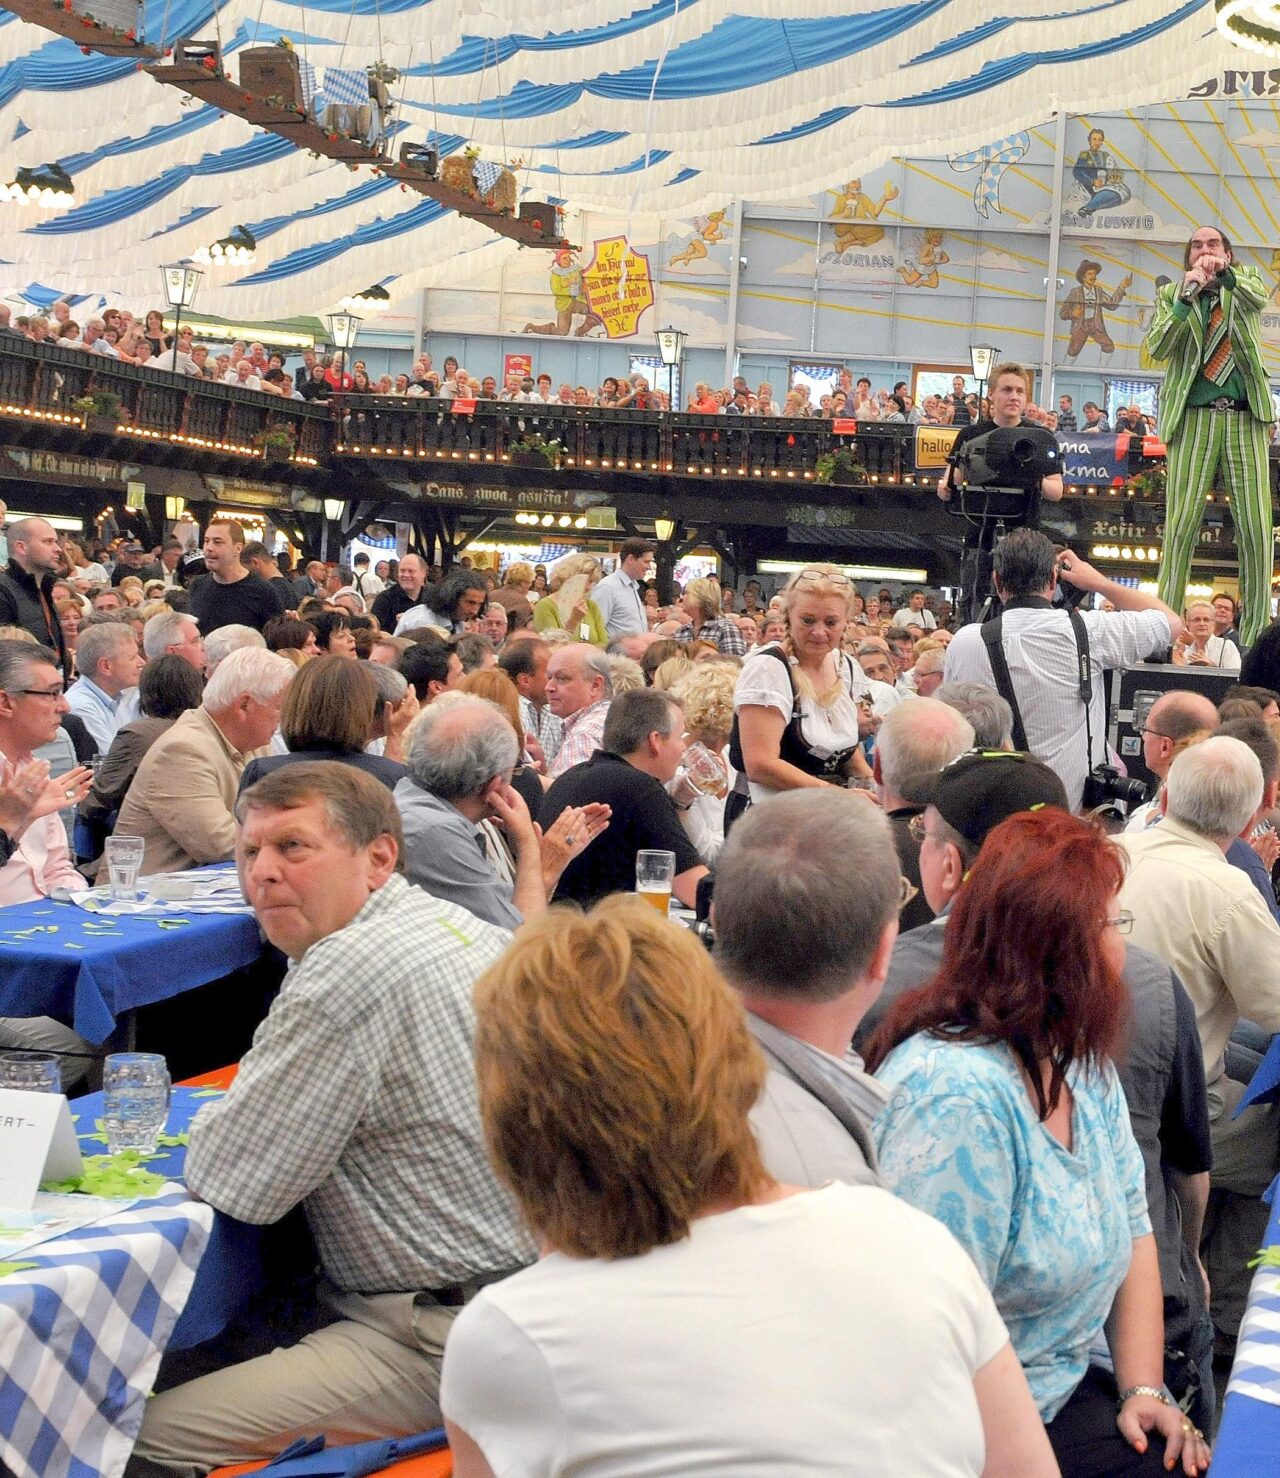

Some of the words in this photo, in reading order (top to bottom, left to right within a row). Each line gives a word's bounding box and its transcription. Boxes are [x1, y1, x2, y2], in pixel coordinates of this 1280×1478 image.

[818, 250, 895, 269] FLORIAN
[1058, 441, 1091, 455] ma
[1062, 461, 1110, 479] kma
